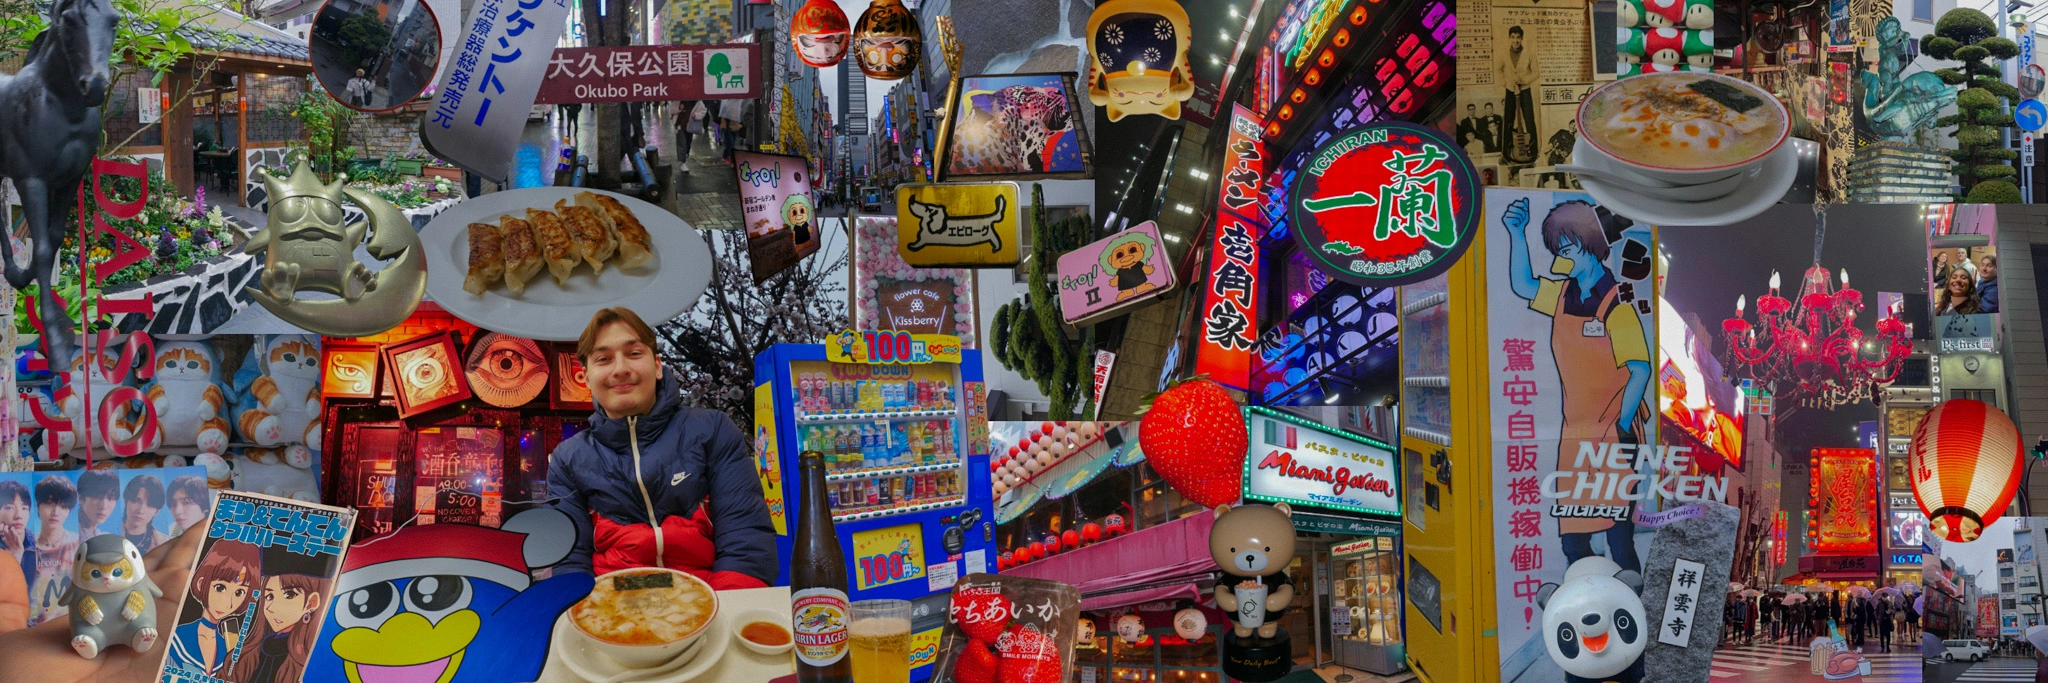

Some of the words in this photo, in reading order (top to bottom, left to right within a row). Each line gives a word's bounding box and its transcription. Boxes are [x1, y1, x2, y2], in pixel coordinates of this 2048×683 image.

[432, 0, 502, 129] 治療器総発売元
[548, 51, 693, 79] 大久保公園
[575, 85, 628, 98] Okubo
[633, 82, 668, 97] Park
[1544, 88, 1573, 101] 新宿
[1310, 130, 1388, 177] ICHIRAN
[1303, 144, 1457, 247] 一蘭
[948, 226, 989, 237] エピローグ
[1350, 250, 1433, 274] 昭和35年創業
[1204, 221, 1255, 351] 壱角家
[894, 288, 921, 302] flower
[923, 288, 940, 301] cafe
[92, 156, 157, 456] DAISO
[895, 316, 913, 326] Kiss
[913, 316, 941, 328] berry
[835, 364, 866, 377] TWO
[872, 364, 909, 377] DOWN
[1889, 443, 1908, 452] Cat
[1573, 441, 1691, 472] NENE
[1258, 450, 1335, 484] Miami
[1502, 338, 1543, 630] 驚安自販機稼働中!
[1540, 471, 1729, 501] CHICKEN
[447, 492, 476, 507] 5:00
[1307, 492, 1363, 506] マイアミガーデン
[1891, 497, 1909, 505] Pet
[215, 500, 348, 540] まり&てんてん
[1550, 504, 1630, 522] 네네치킨
[1639, 511, 1665, 525] Happy
[1667, 508, 1694, 521] Choice
[1293, 519, 1344, 530] スタとピザの店
[1349, 522, 1374, 533] Miami
[209, 521, 342, 557] ダブルバースデー
[859, 531, 916, 550] ちょっとしあわせ
[1892, 555, 1905, 563] 16
[949, 596, 1061, 625] とちあいか
[1668, 568, 1697, 637] 祥雲寺
[794, 632, 816, 645] KIRIN
[817, 631, 846, 645] LAGER
[1002, 652, 1021, 660] SMILE
[1022, 653, 1051, 662] MONKEYS
[164, 666, 191, 679] 2024
